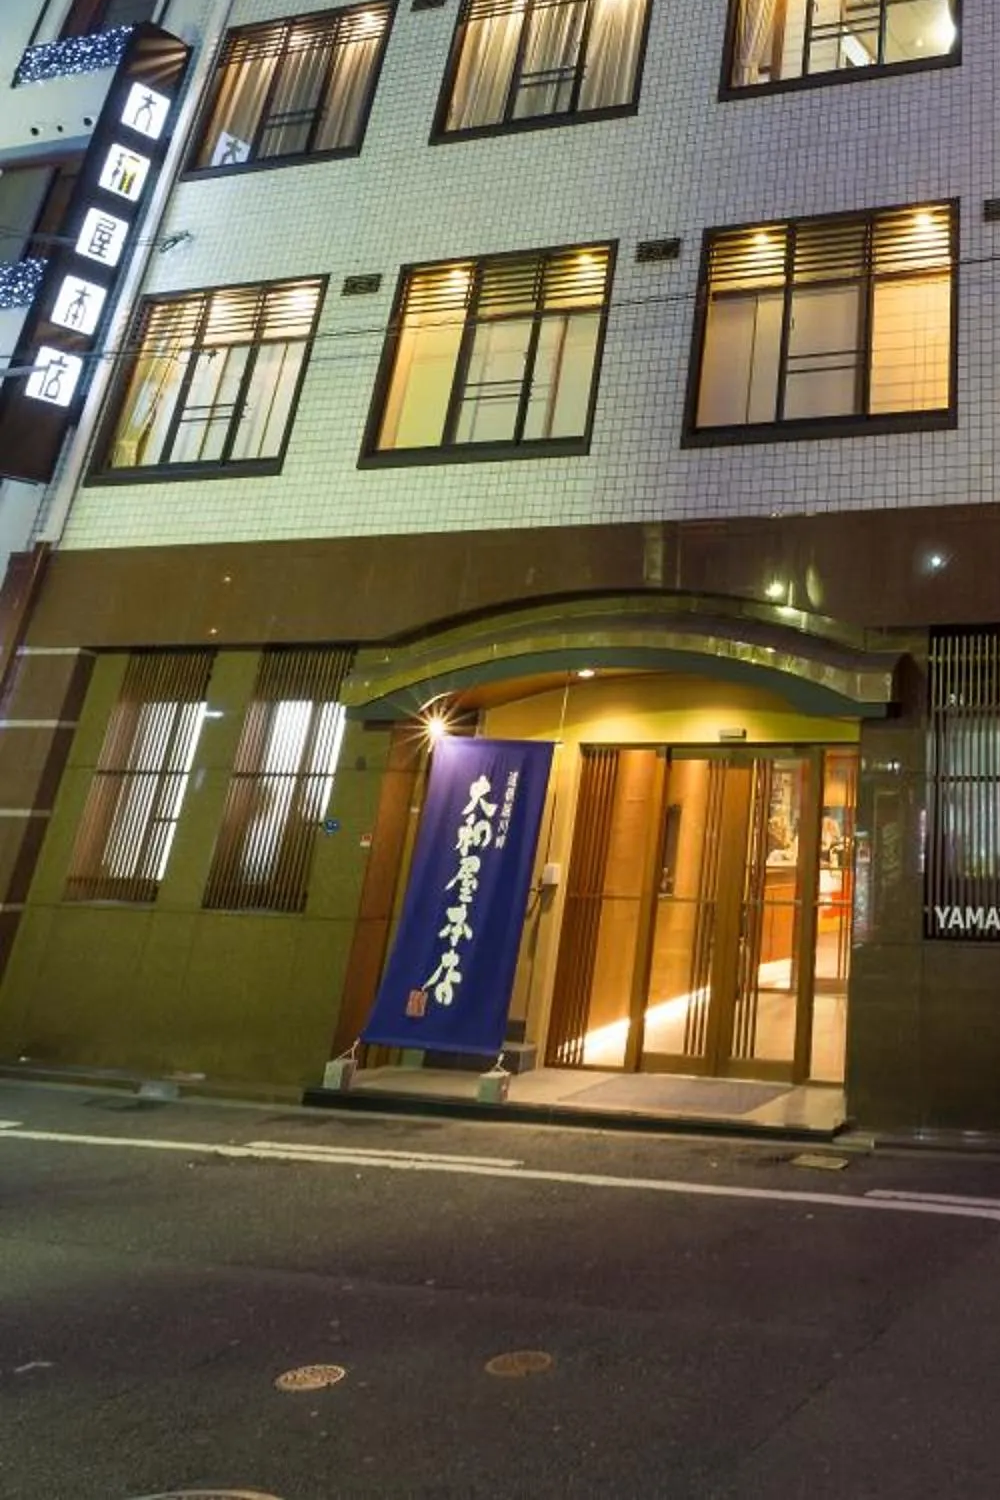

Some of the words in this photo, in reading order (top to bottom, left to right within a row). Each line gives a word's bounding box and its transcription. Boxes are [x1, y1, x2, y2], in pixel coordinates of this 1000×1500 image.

[421, 774, 498, 1006] 大和屋本店
